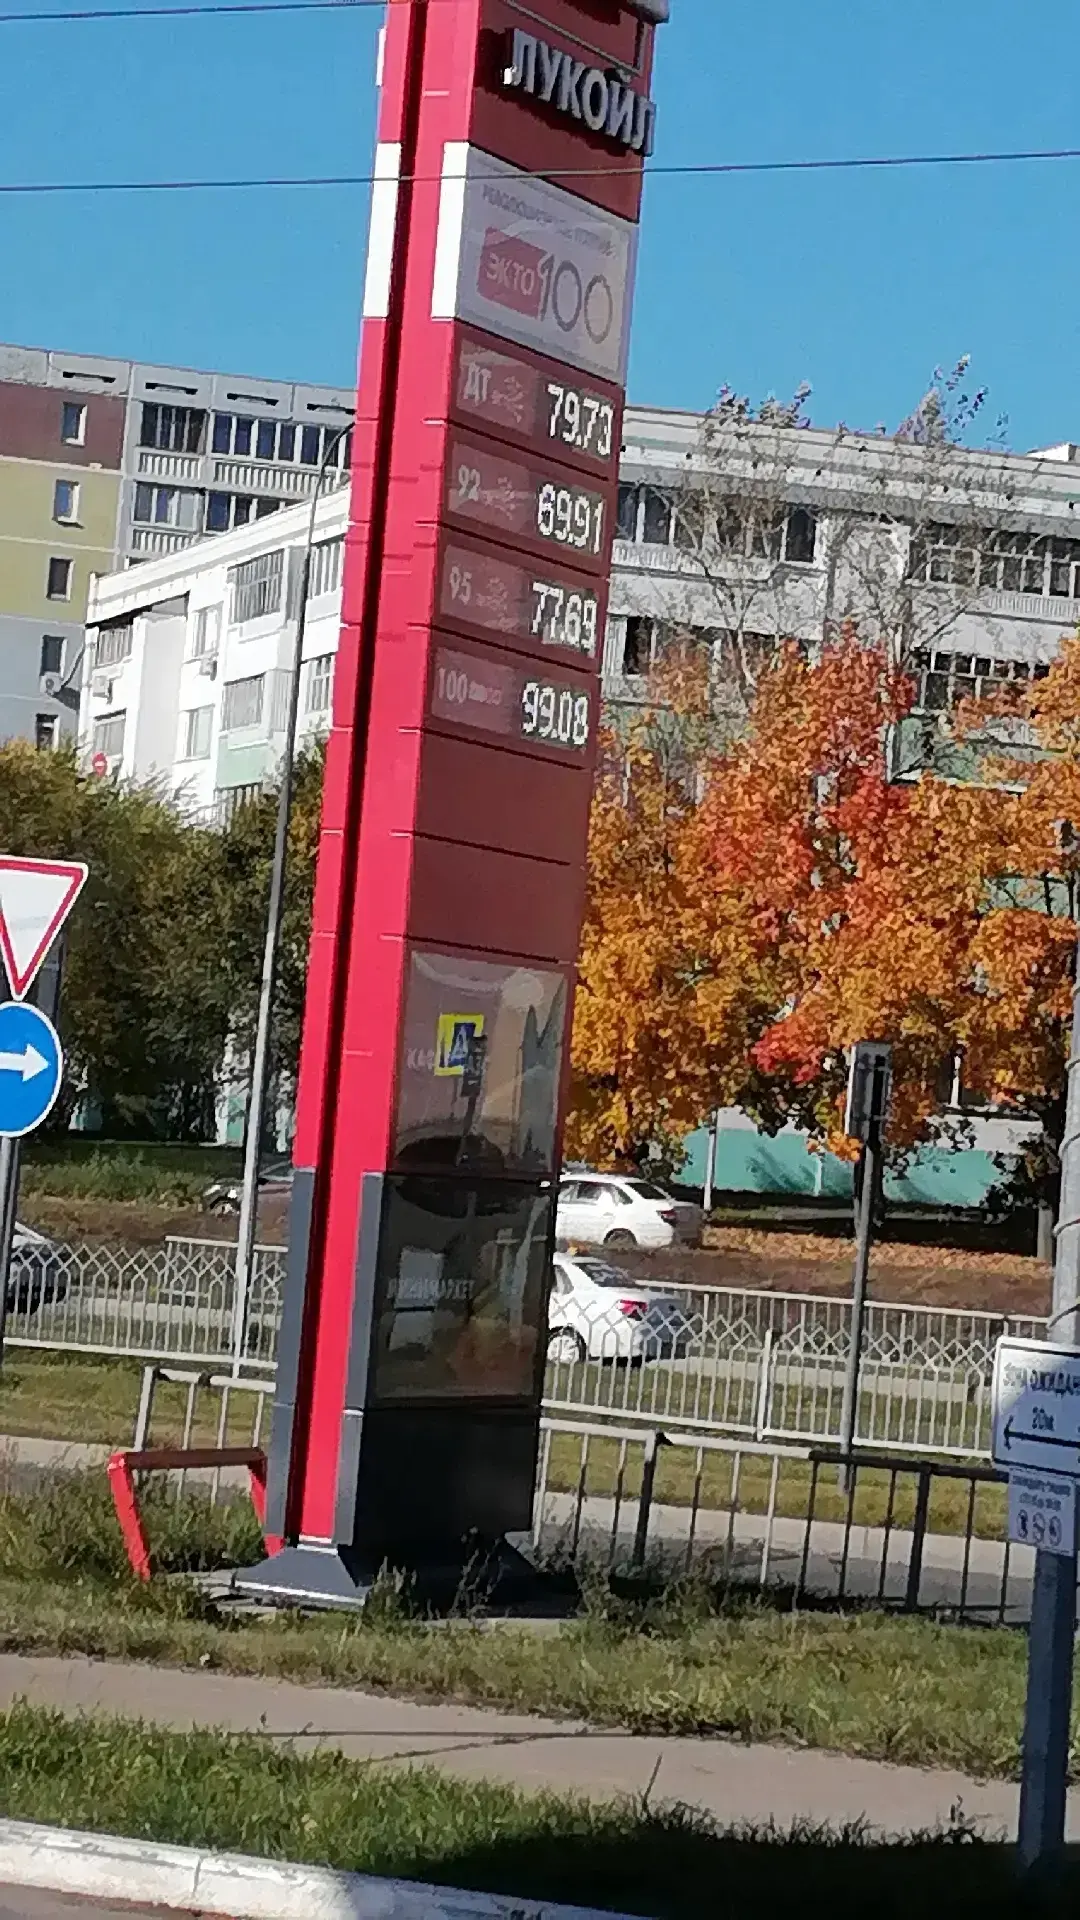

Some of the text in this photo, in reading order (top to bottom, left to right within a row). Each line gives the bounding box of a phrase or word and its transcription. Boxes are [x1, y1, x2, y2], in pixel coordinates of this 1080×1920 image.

[503, 28, 657, 157] ЛУКОЙЛ
[485, 251, 613, 345] ЭКТО 100
[547, 383, 614, 456] 79.73
[458, 463, 481, 502] 92
[449, 565, 472, 605] 95
[530, 581, 598, 659] 77.69
[438, 667, 468, 704] 100
